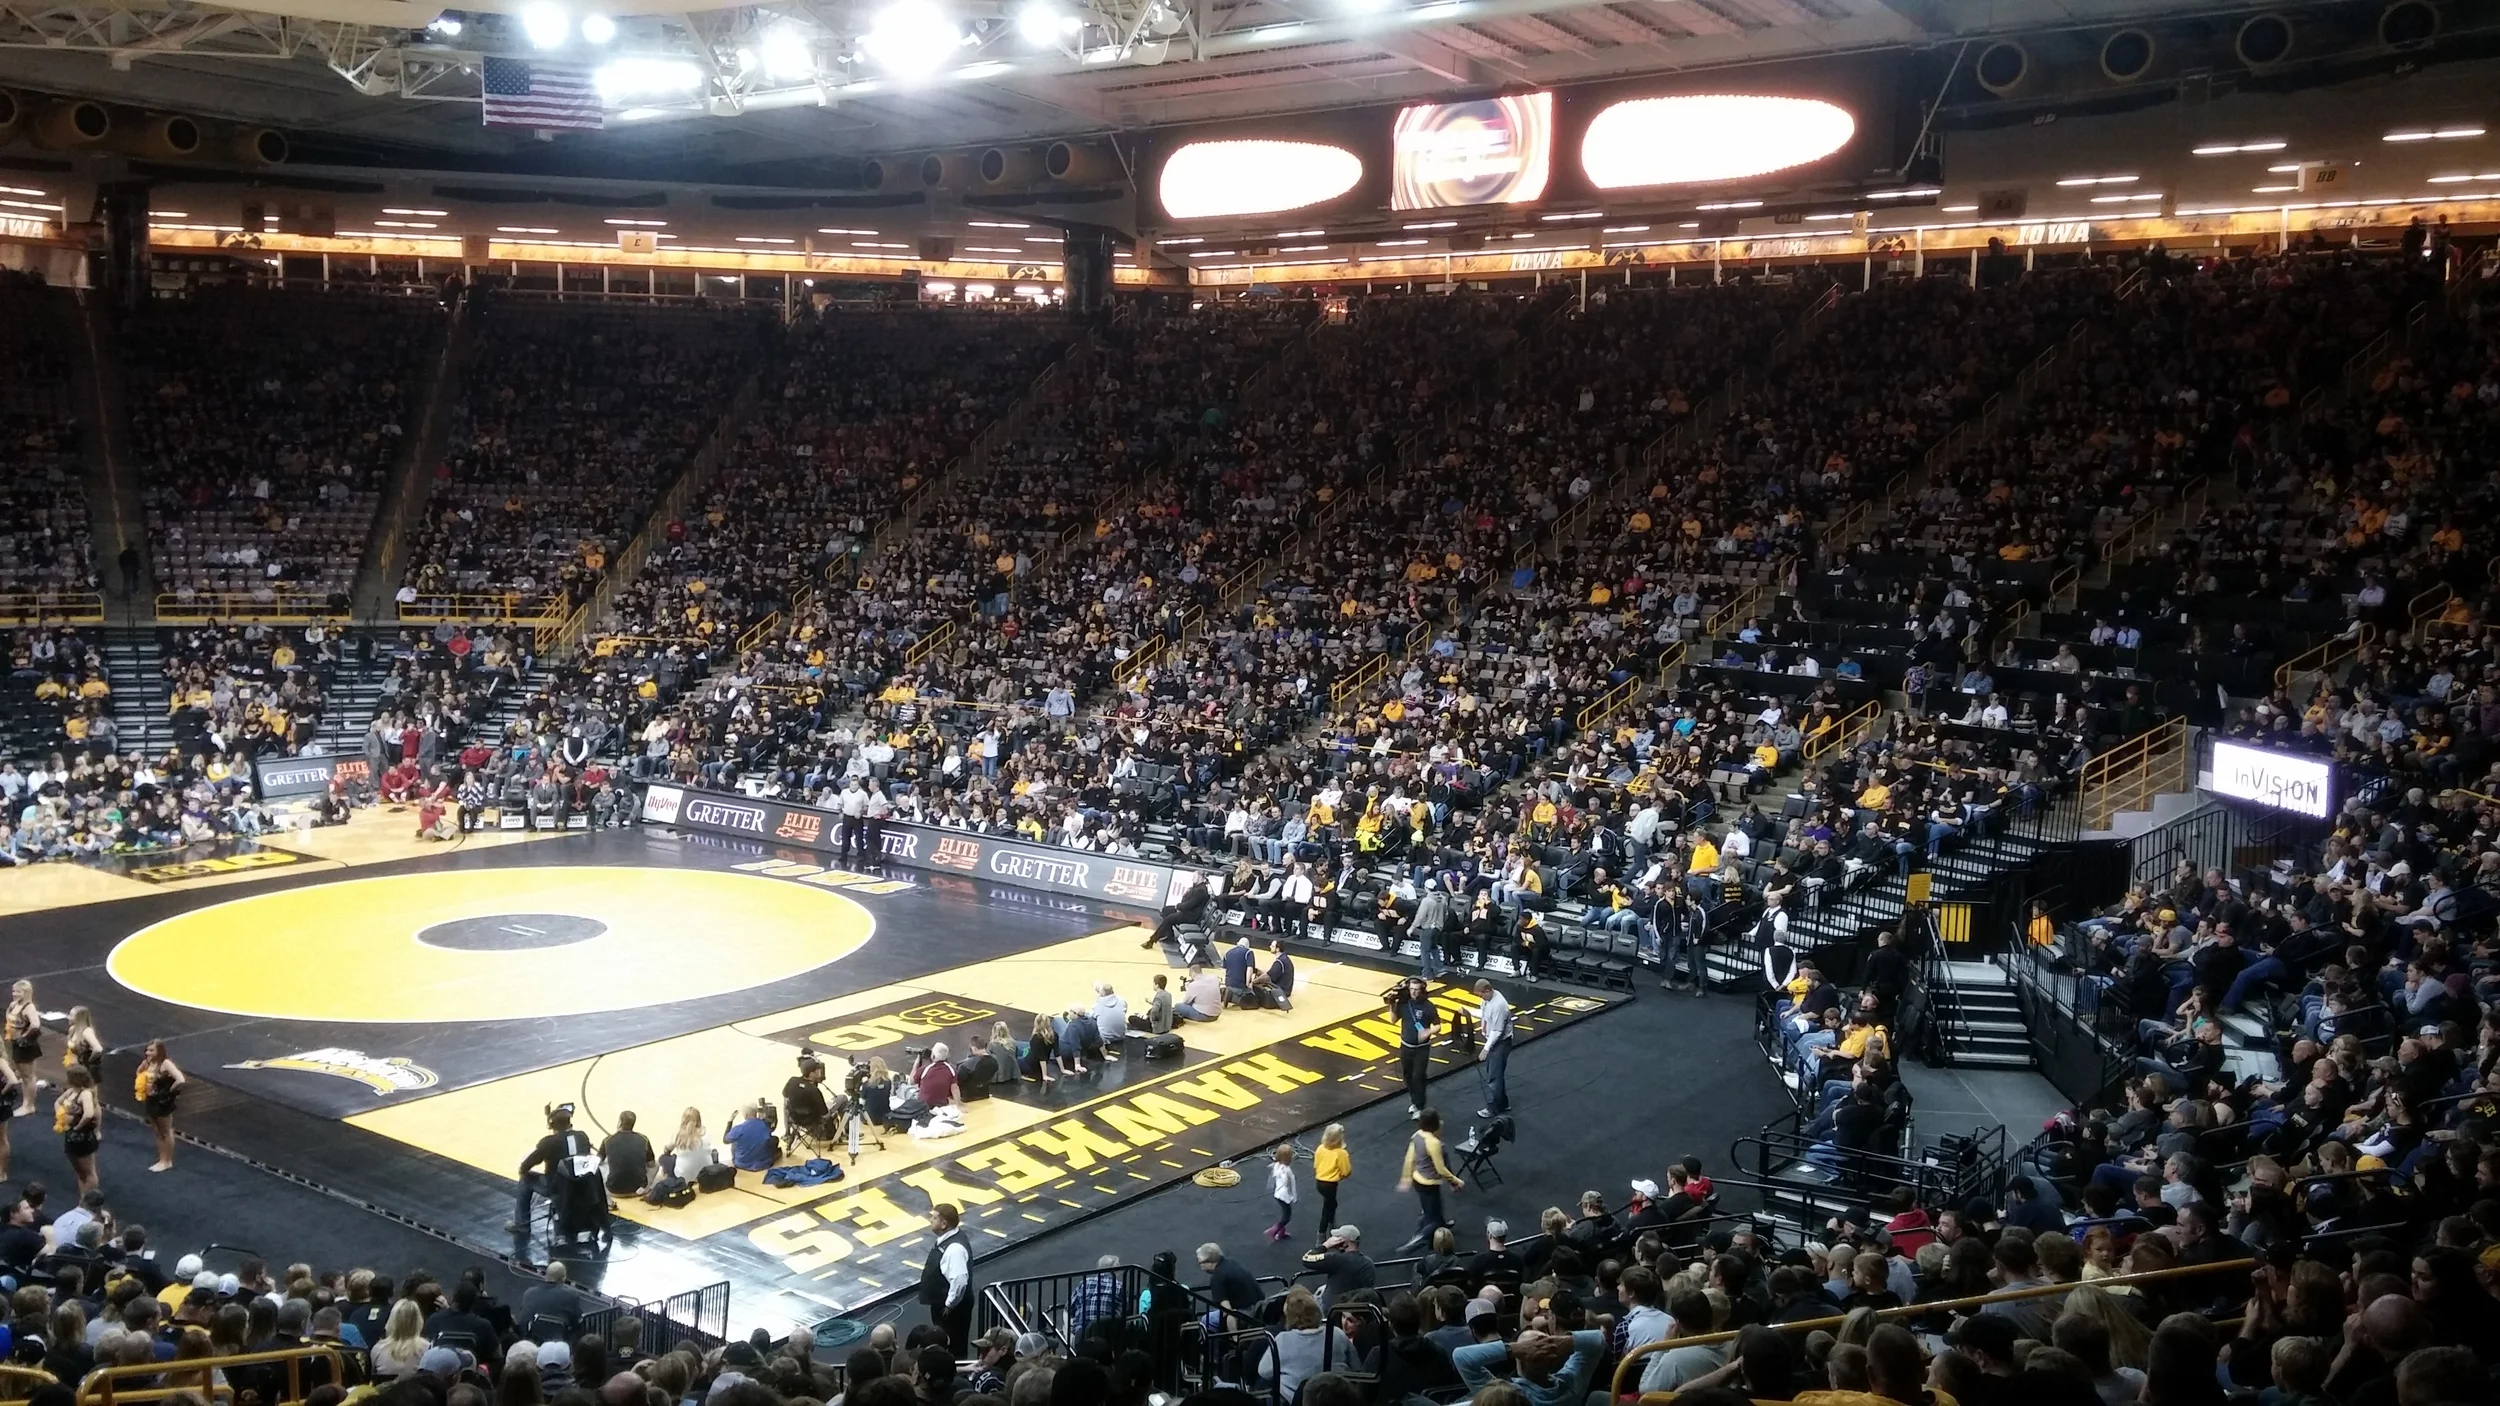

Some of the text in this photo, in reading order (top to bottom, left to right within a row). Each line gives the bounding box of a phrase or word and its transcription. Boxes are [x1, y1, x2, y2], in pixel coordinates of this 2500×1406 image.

[2315, 170, 2338, 183] BB
[633, 238, 642, 247] E
[2015, 222, 2090, 245] IOWA
[1510, 252, 1564, 271] IOWA
[263, 767, 330, 787] GRETTER
[335, 760, 370, 774] ELITE
[2235, 765, 2318, 804] InVISION
[686, 799, 766, 832] GRETTER
[784, 811, 822, 831] ELITE
[938, 837, 980, 858] ELITE
[990, 849, 1090, 889] GRETTER
[1112, 866, 1159, 888] ELITE
[1228, 910, 1242, 919] zero
[1344, 931, 1360, 939] zero
[747, 1052, 1326, 1275] HAWKEYES
